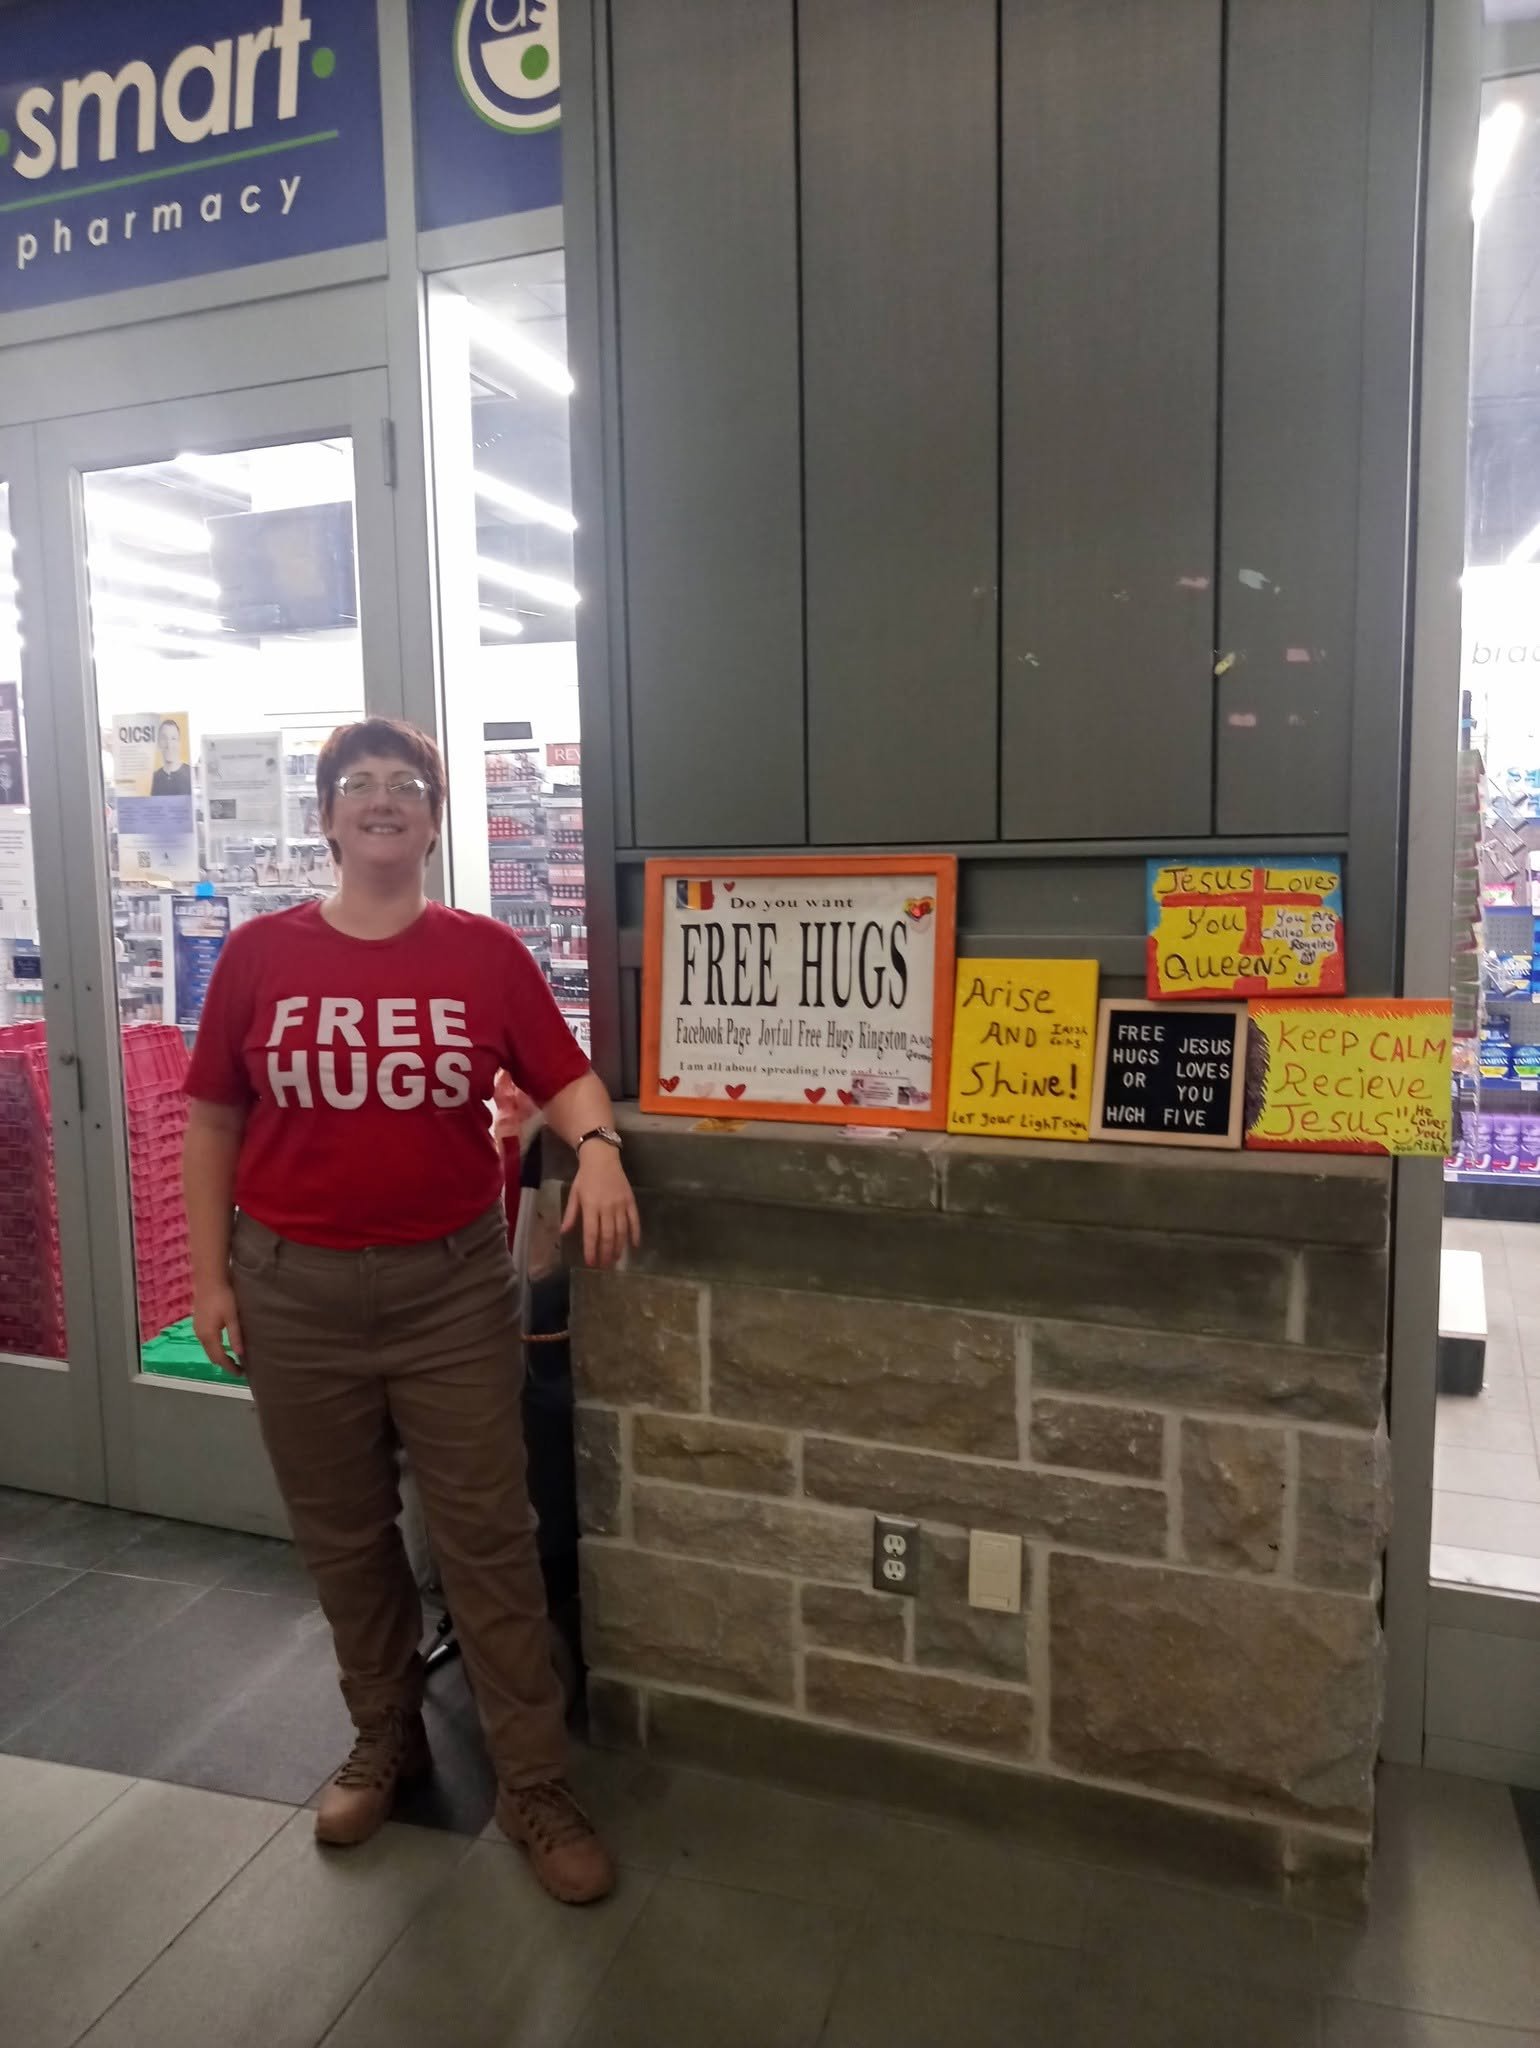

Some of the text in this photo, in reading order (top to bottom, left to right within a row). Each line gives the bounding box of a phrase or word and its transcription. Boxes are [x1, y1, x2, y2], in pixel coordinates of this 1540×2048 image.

[12, 0, 311, 179] smart
[17, 176, 301, 270] pharmacy
[119, 726, 156, 743] QICSI
[730, 897, 853, 912] Do you want
[680, 920, 908, 1009] FREE HUGS
[962, 978, 1055, 1013] Arise
[265, 996, 474, 1048] FREE
[1118, 1025, 1166, 1042] FREE
[676, 1017, 907, 1060] Facebook Page Joyful Free Hugs Kingston
[980, 1021, 1037, 1048] AND
[1179, 1038, 1232, 1055] JESUS
[1113, 1048, 1160, 1065] HUGS
[1370, 1032, 1447, 1064] CALM
[267, 1050, 473, 1110] HUGS
[687, 1062, 704, 1072] am
[707, 1061, 722, 1073] all
[725, 1062, 757, 1073] about
[761, 1065, 818, 1078] spreading
[822, 1065, 847, 1076] love
[1123, 1072, 1146, 1088] OR
[1176, 1062, 1230, 1079] LOVES
[1274, 1062, 1432, 1100] Recieve
[1177, 1085, 1214, 1102] YOU
[1106, 1105, 1207, 1126] HIGH FIVE
